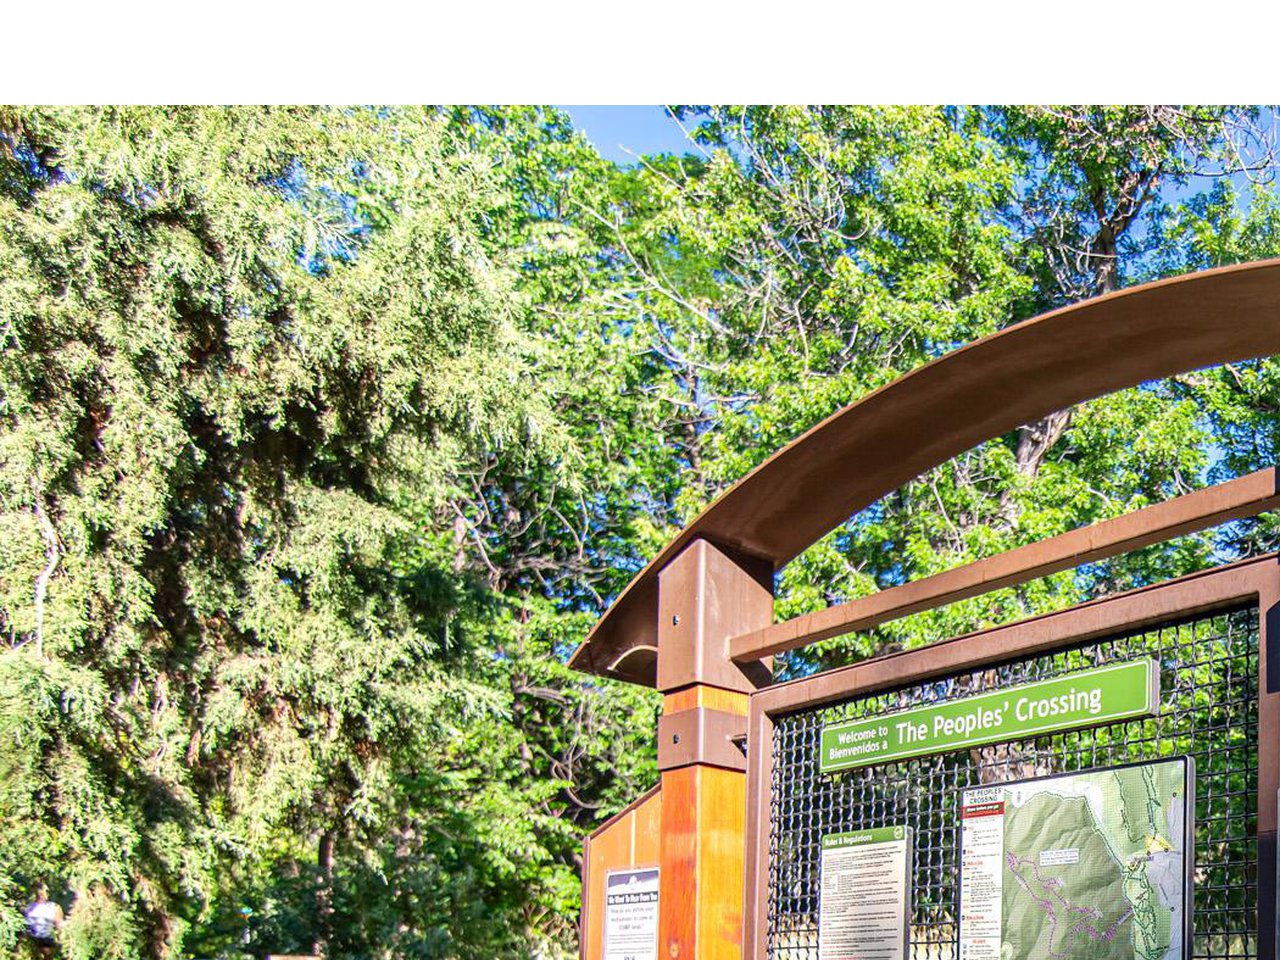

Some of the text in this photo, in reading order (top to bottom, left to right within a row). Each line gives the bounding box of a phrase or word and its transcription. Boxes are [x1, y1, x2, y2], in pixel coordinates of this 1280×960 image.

[895, 722, 927, 745] The
[1015, 687, 1102, 722] Crossing
[838, 725, 888, 745] Welcome to
[829, 739, 888, 760] Bienvenidos a
[825, 838, 838, 846] Rules
[843, 834, 873, 845] Regulations
